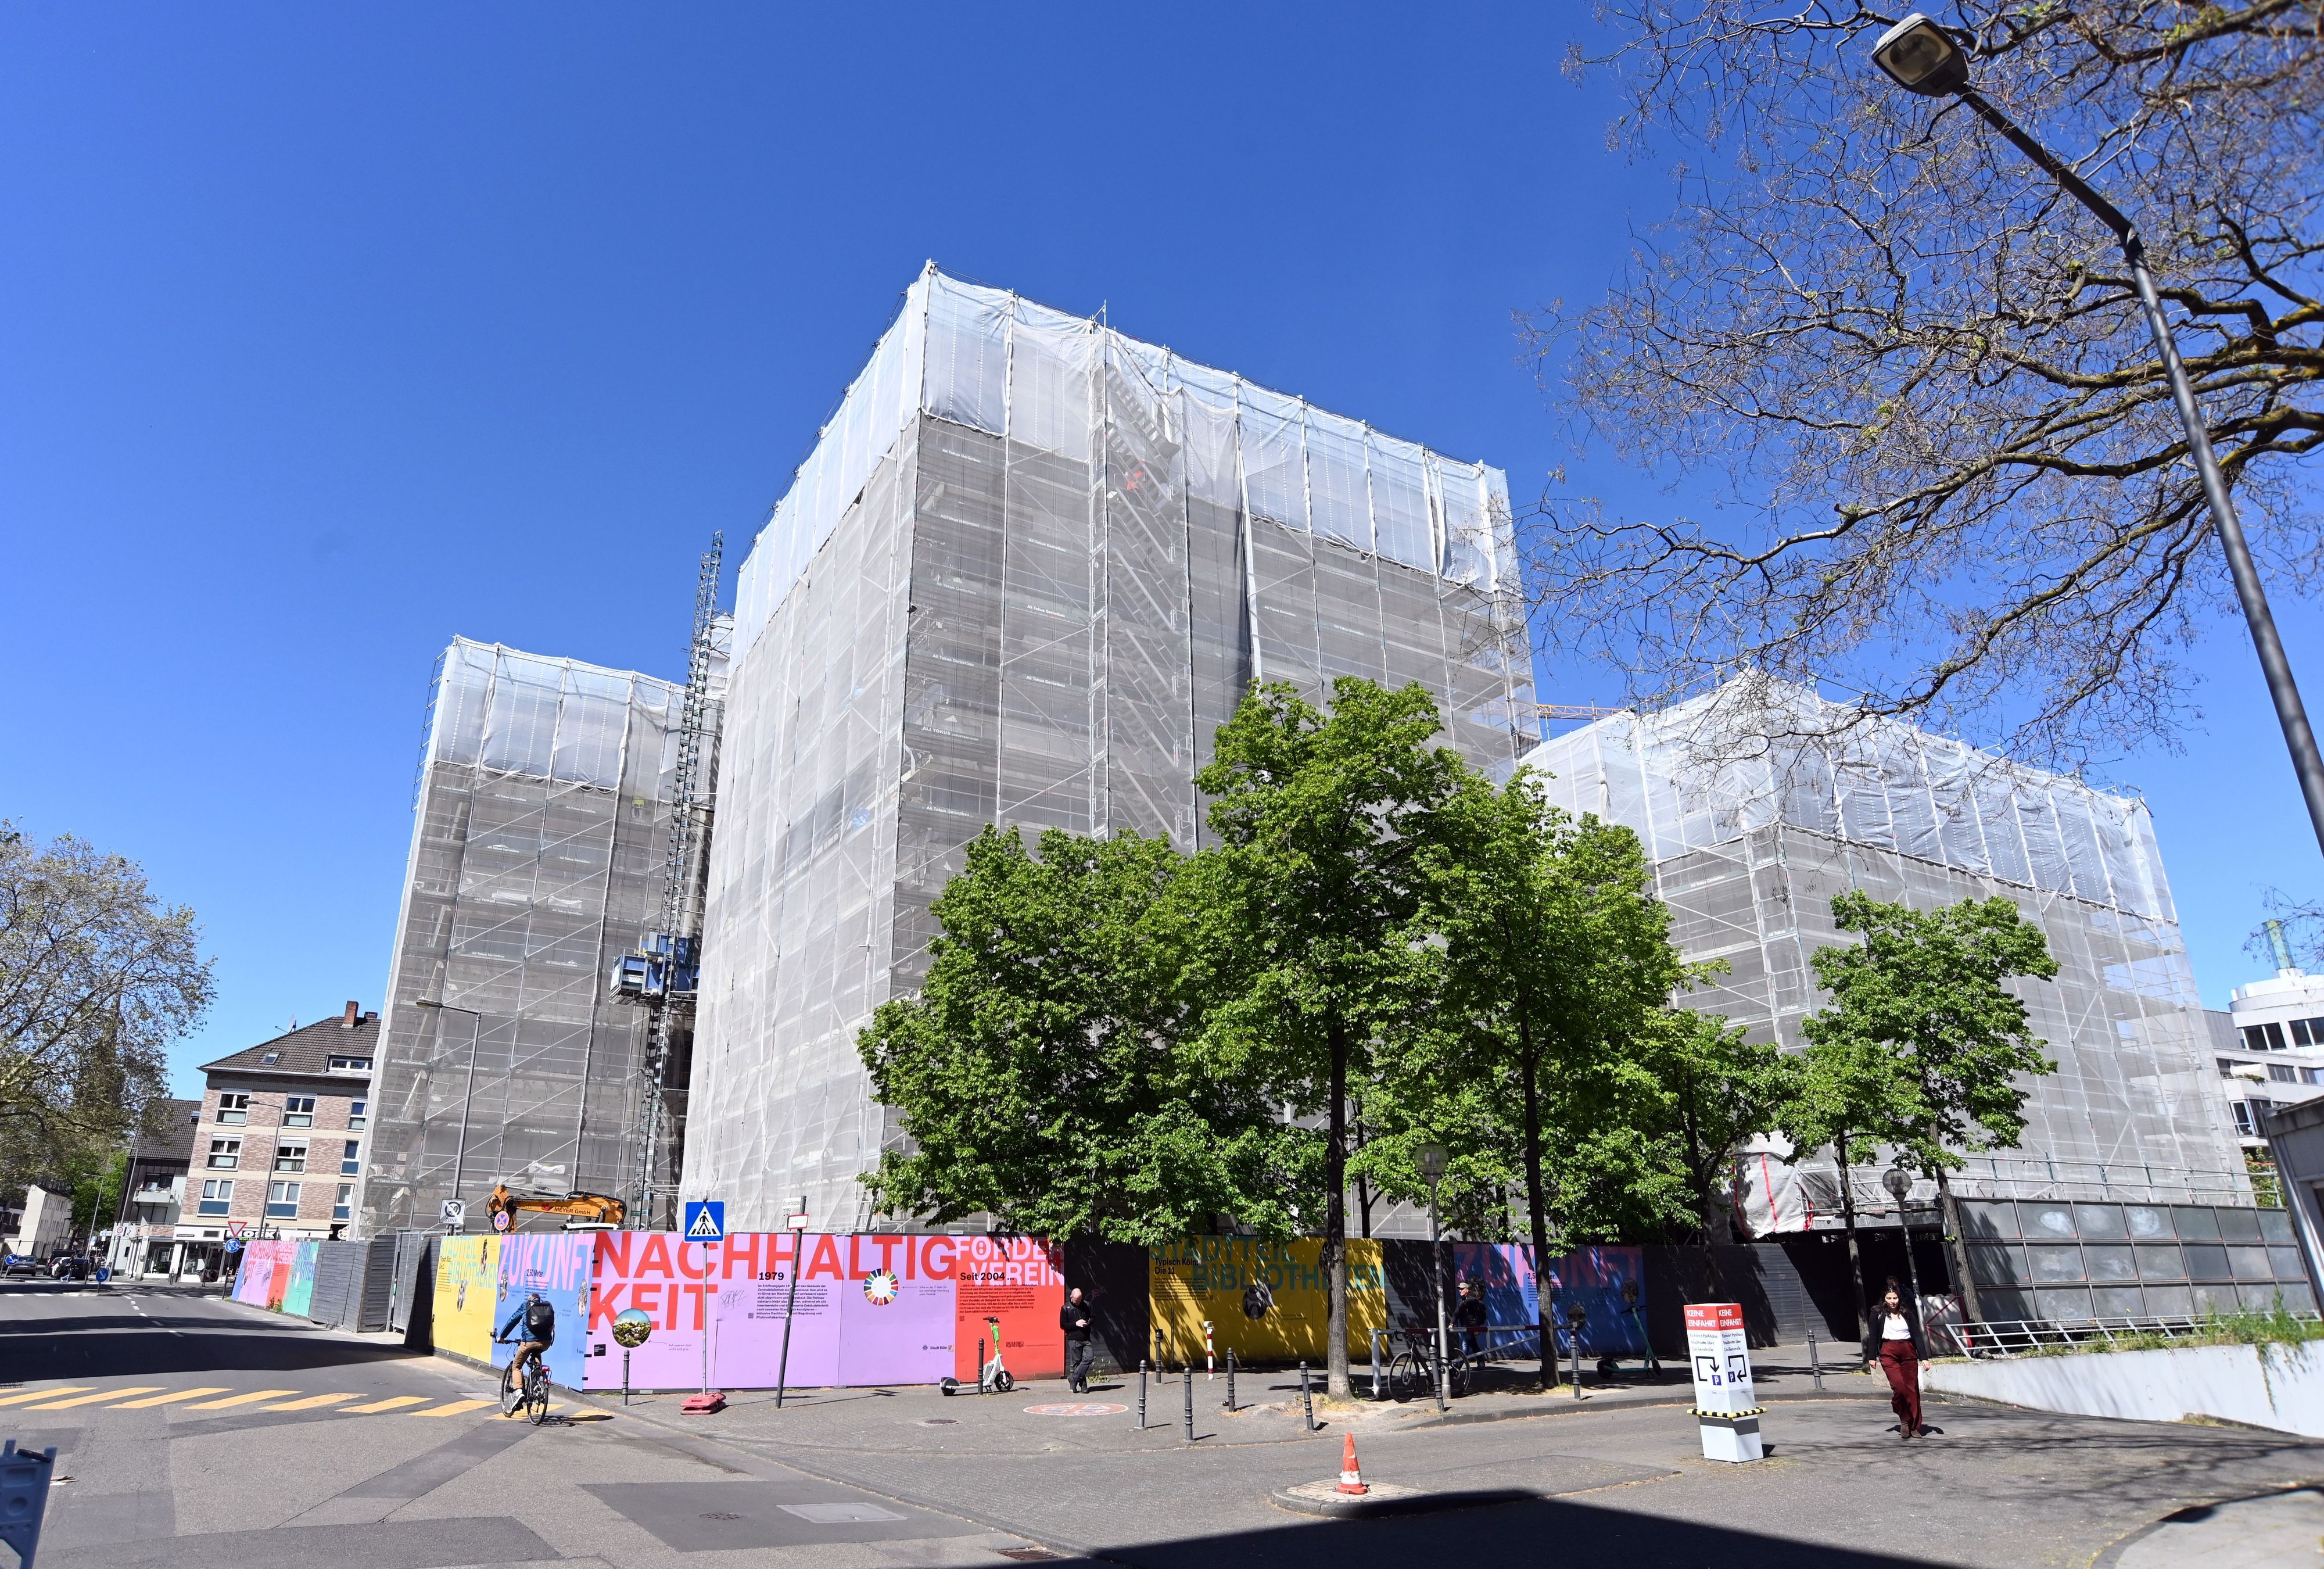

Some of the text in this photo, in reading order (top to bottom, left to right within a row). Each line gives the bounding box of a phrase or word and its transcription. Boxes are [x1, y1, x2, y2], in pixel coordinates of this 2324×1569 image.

[592, 1231, 956, 1281] NACHHALTIG
[498, 1234, 596, 1291] ZUKUNFT
[1155, 1258, 1199, 1266] Typisch Köln:
[534, 1269, 543, 1277] Meter
[759, 1271, 784, 1280] 1979
[960, 1272, 978, 1280] Seit
[981, 1272, 1005, 1280] 2004
[970, 1262, 1064, 1286] VEREIN
[588, 1283, 718, 1330] KEIT
[1720, 1318, 1742, 1327] EINFAHRT
